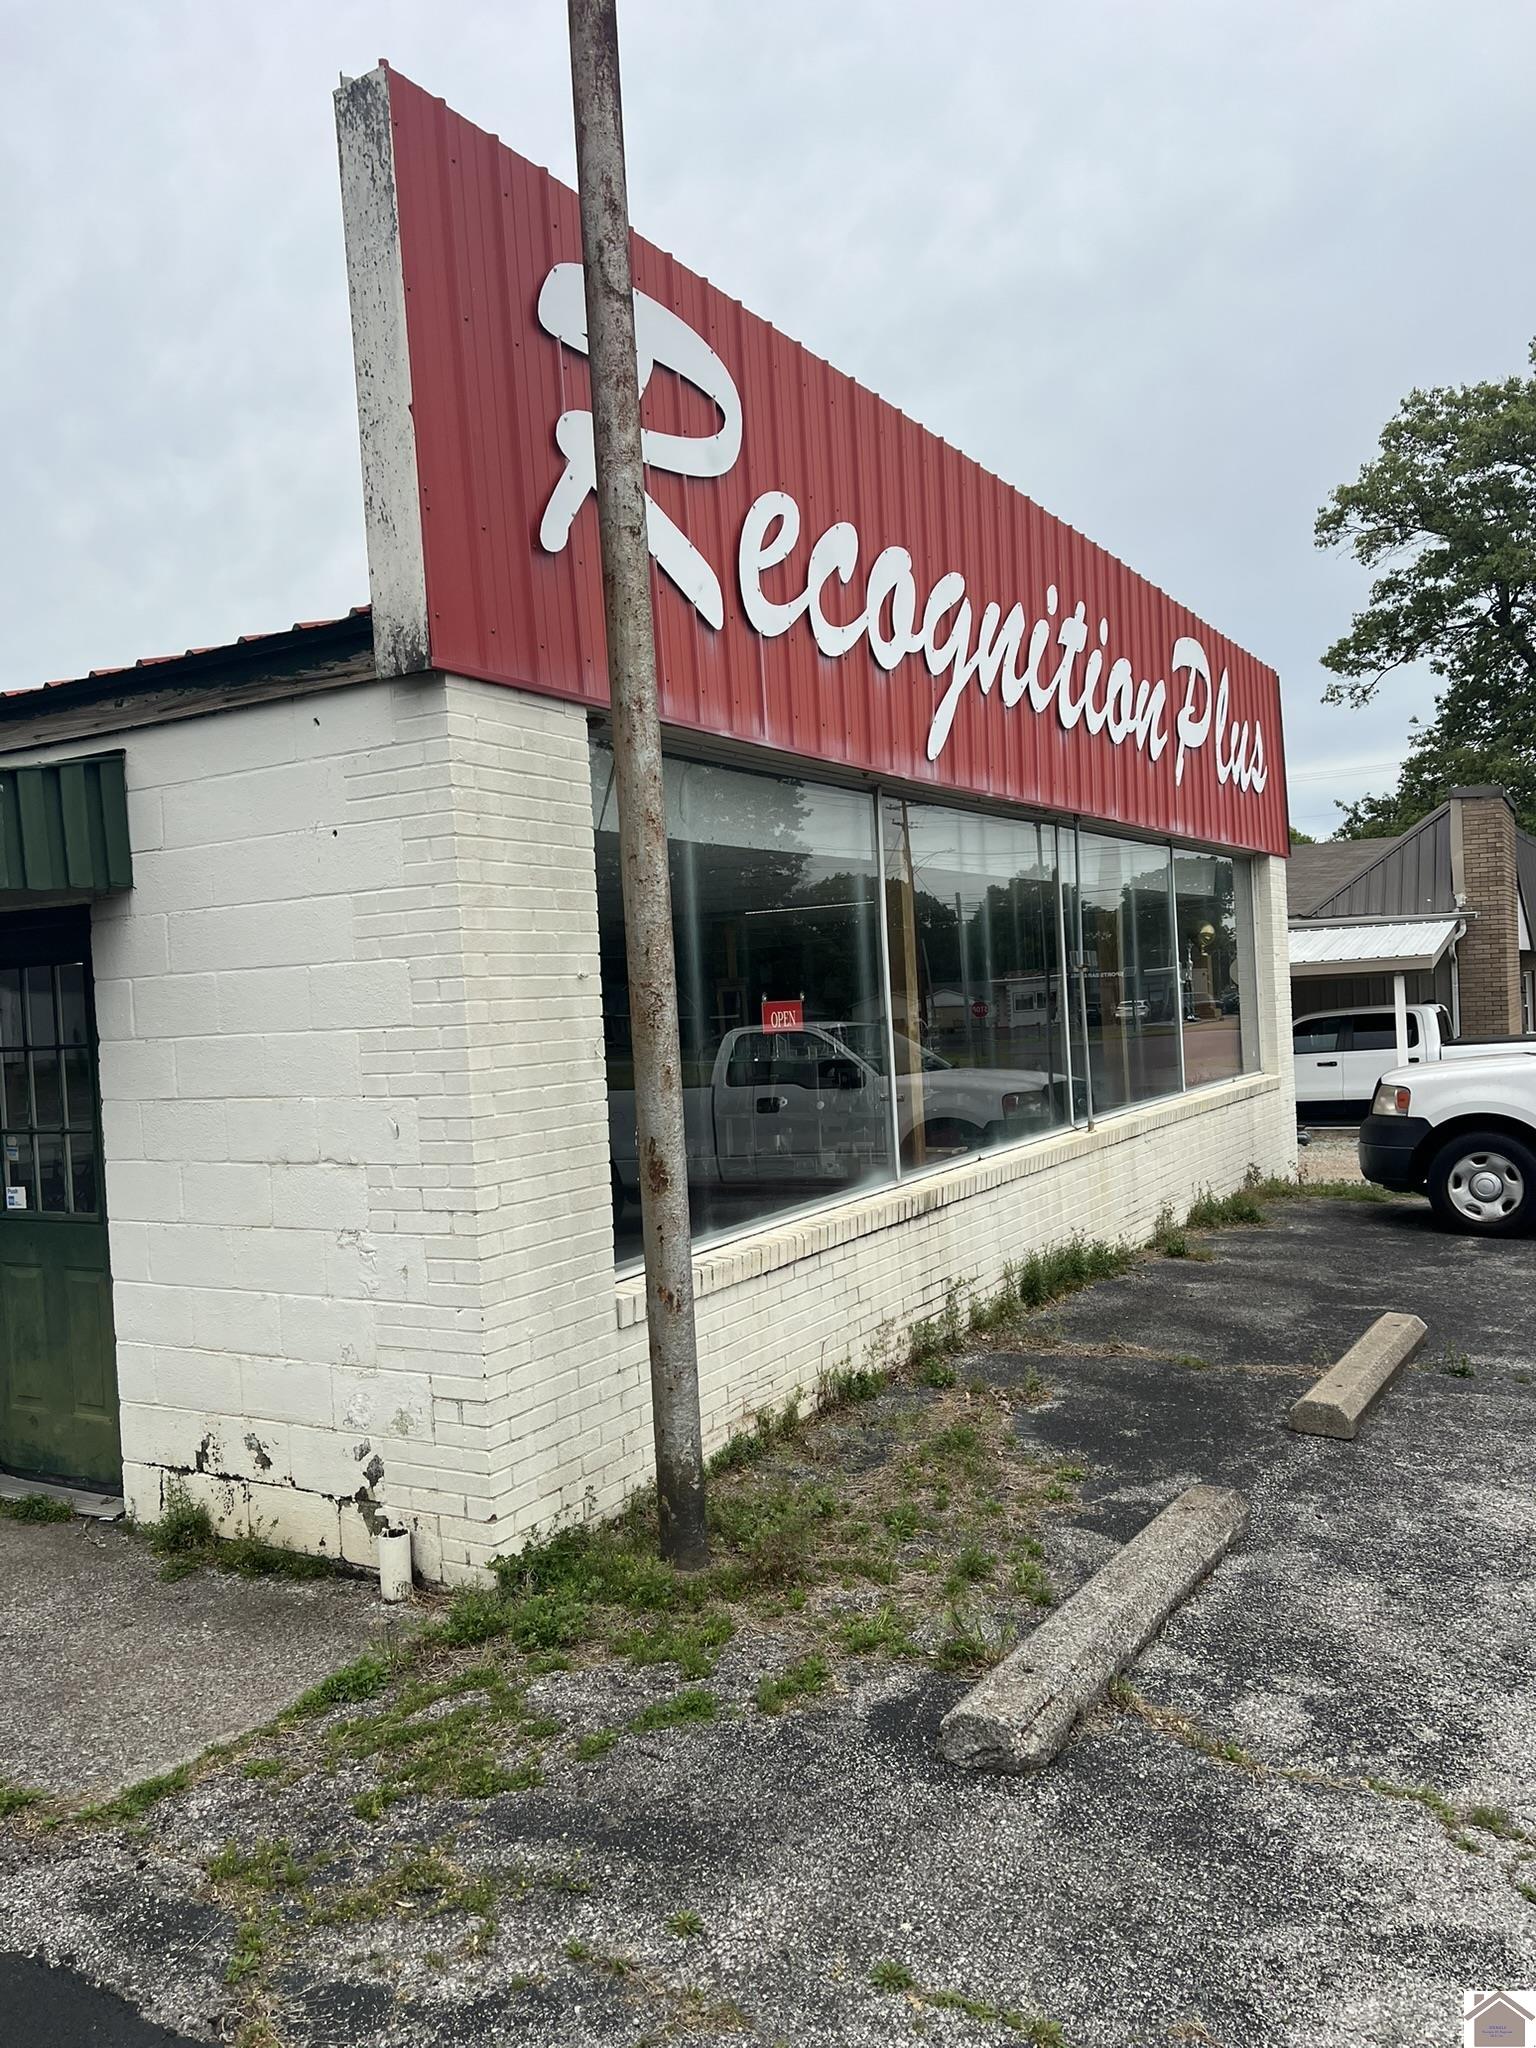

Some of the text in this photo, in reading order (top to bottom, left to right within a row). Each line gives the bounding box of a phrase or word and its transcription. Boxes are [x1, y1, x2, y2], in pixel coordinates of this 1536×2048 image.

[538, 262, 1268, 794] Recognition Plus
[770, 1010, 796, 1028] OPEN
